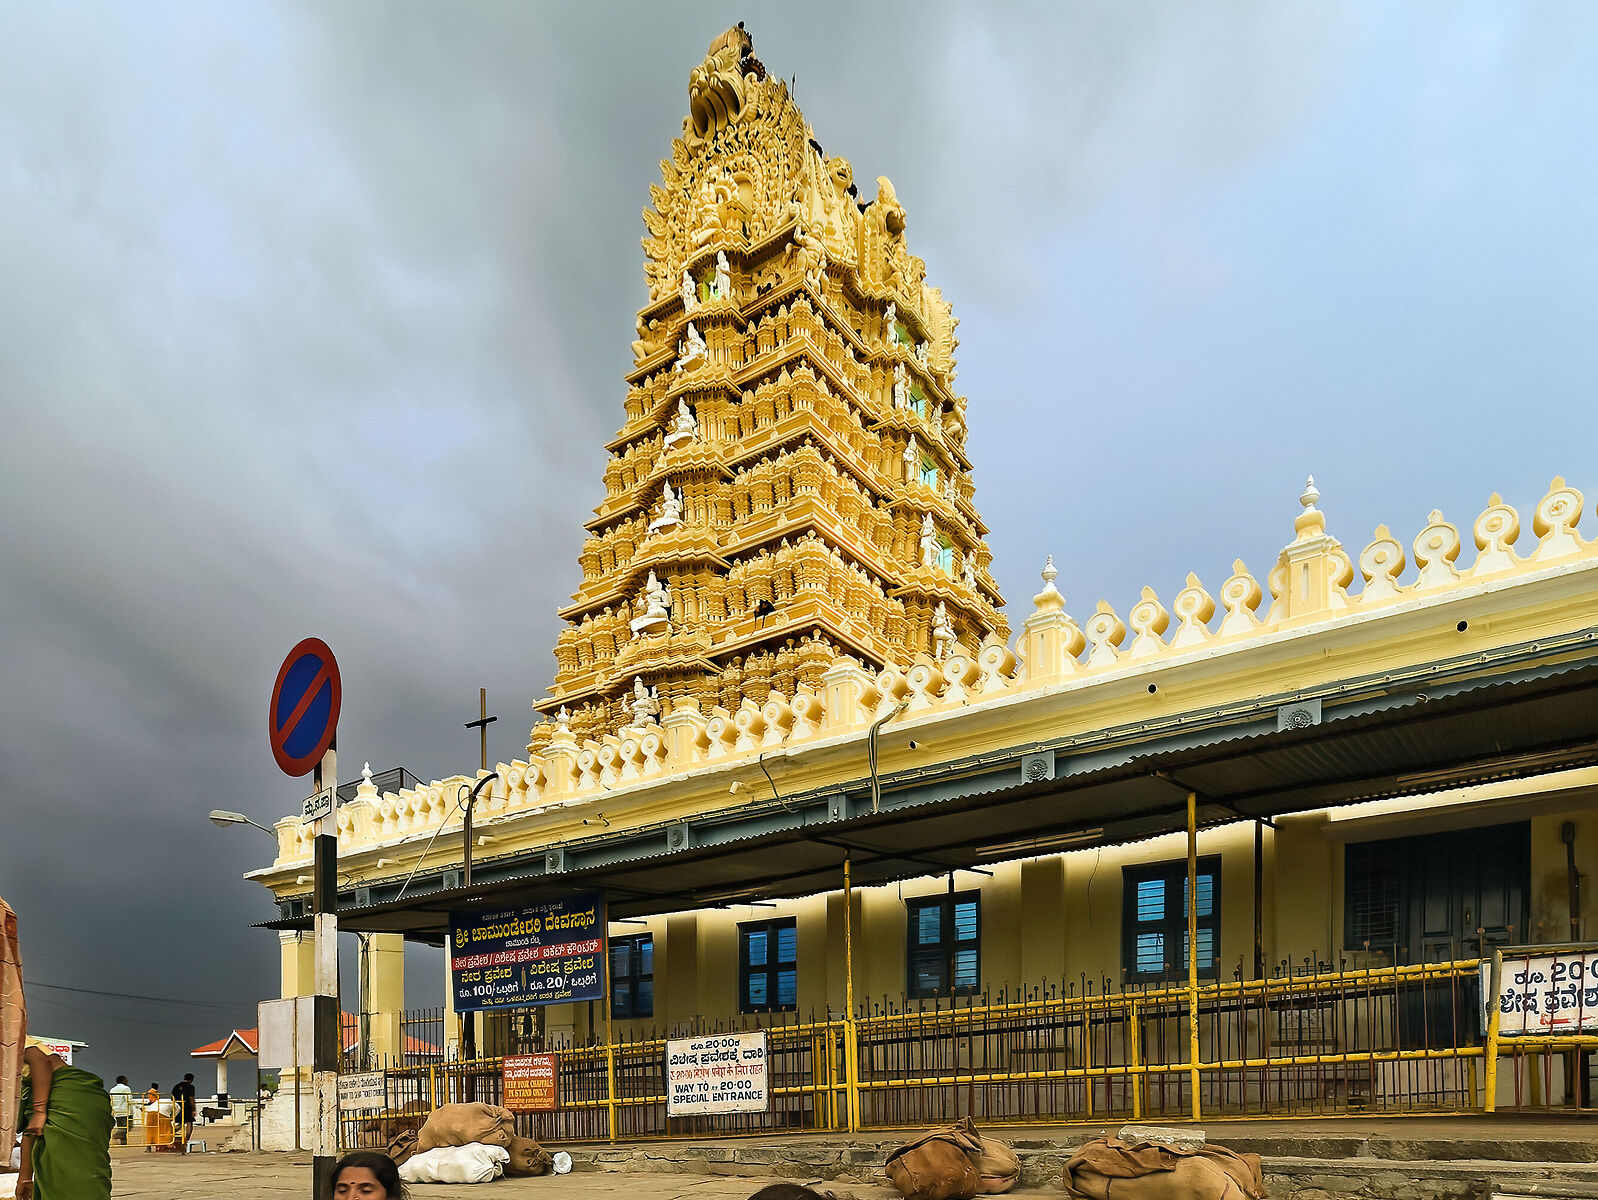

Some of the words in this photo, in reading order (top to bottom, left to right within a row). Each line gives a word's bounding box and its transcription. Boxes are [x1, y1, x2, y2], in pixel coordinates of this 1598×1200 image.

[456, 928, 469, 948] ಶ್ರೀ
[530, 959, 560, 975] ವಿಶೇಷ
[564, 956, 594, 974] ಪ್ರವೇಶ
[484, 966, 512, 984] ಪ್ರವೇಶ
[1514, 970, 1548, 984] ರೂ.
[670, 1053, 698, 1066] ವಿಶೇಷ
[742, 1048, 764, 1060] ದಾರಿ
[514, 1089, 532, 1097] STAND
[532, 1088, 548, 1096] ONLY
[675, 1083, 694, 1094] WAY
[697, 1082, 709, 1092] TO
[673, 1093, 709, 1104] SPECIAL
[712, 1090, 763, 1102] ENTRANCE
